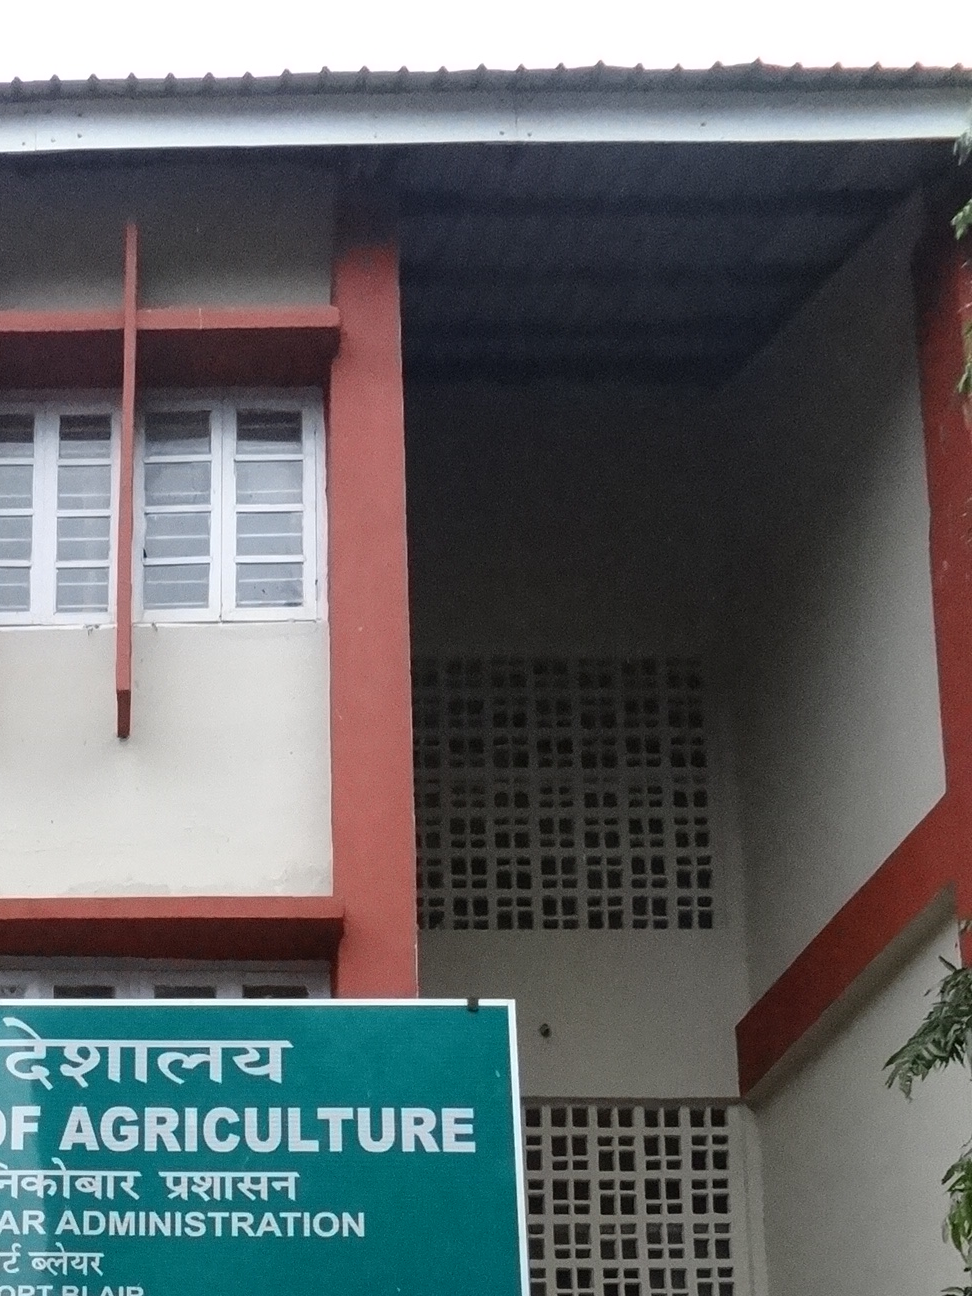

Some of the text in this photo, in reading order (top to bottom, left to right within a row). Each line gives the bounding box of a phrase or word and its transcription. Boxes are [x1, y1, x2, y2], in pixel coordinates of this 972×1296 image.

[58, 1105, 476, 1153] AGRICULTURE
[158, 1171, 300, 1202] प्रशासन
[54, 1210, 365, 1238] ADMINISTRATION
[27, 1241, 104, 1276] ब्लेयर
